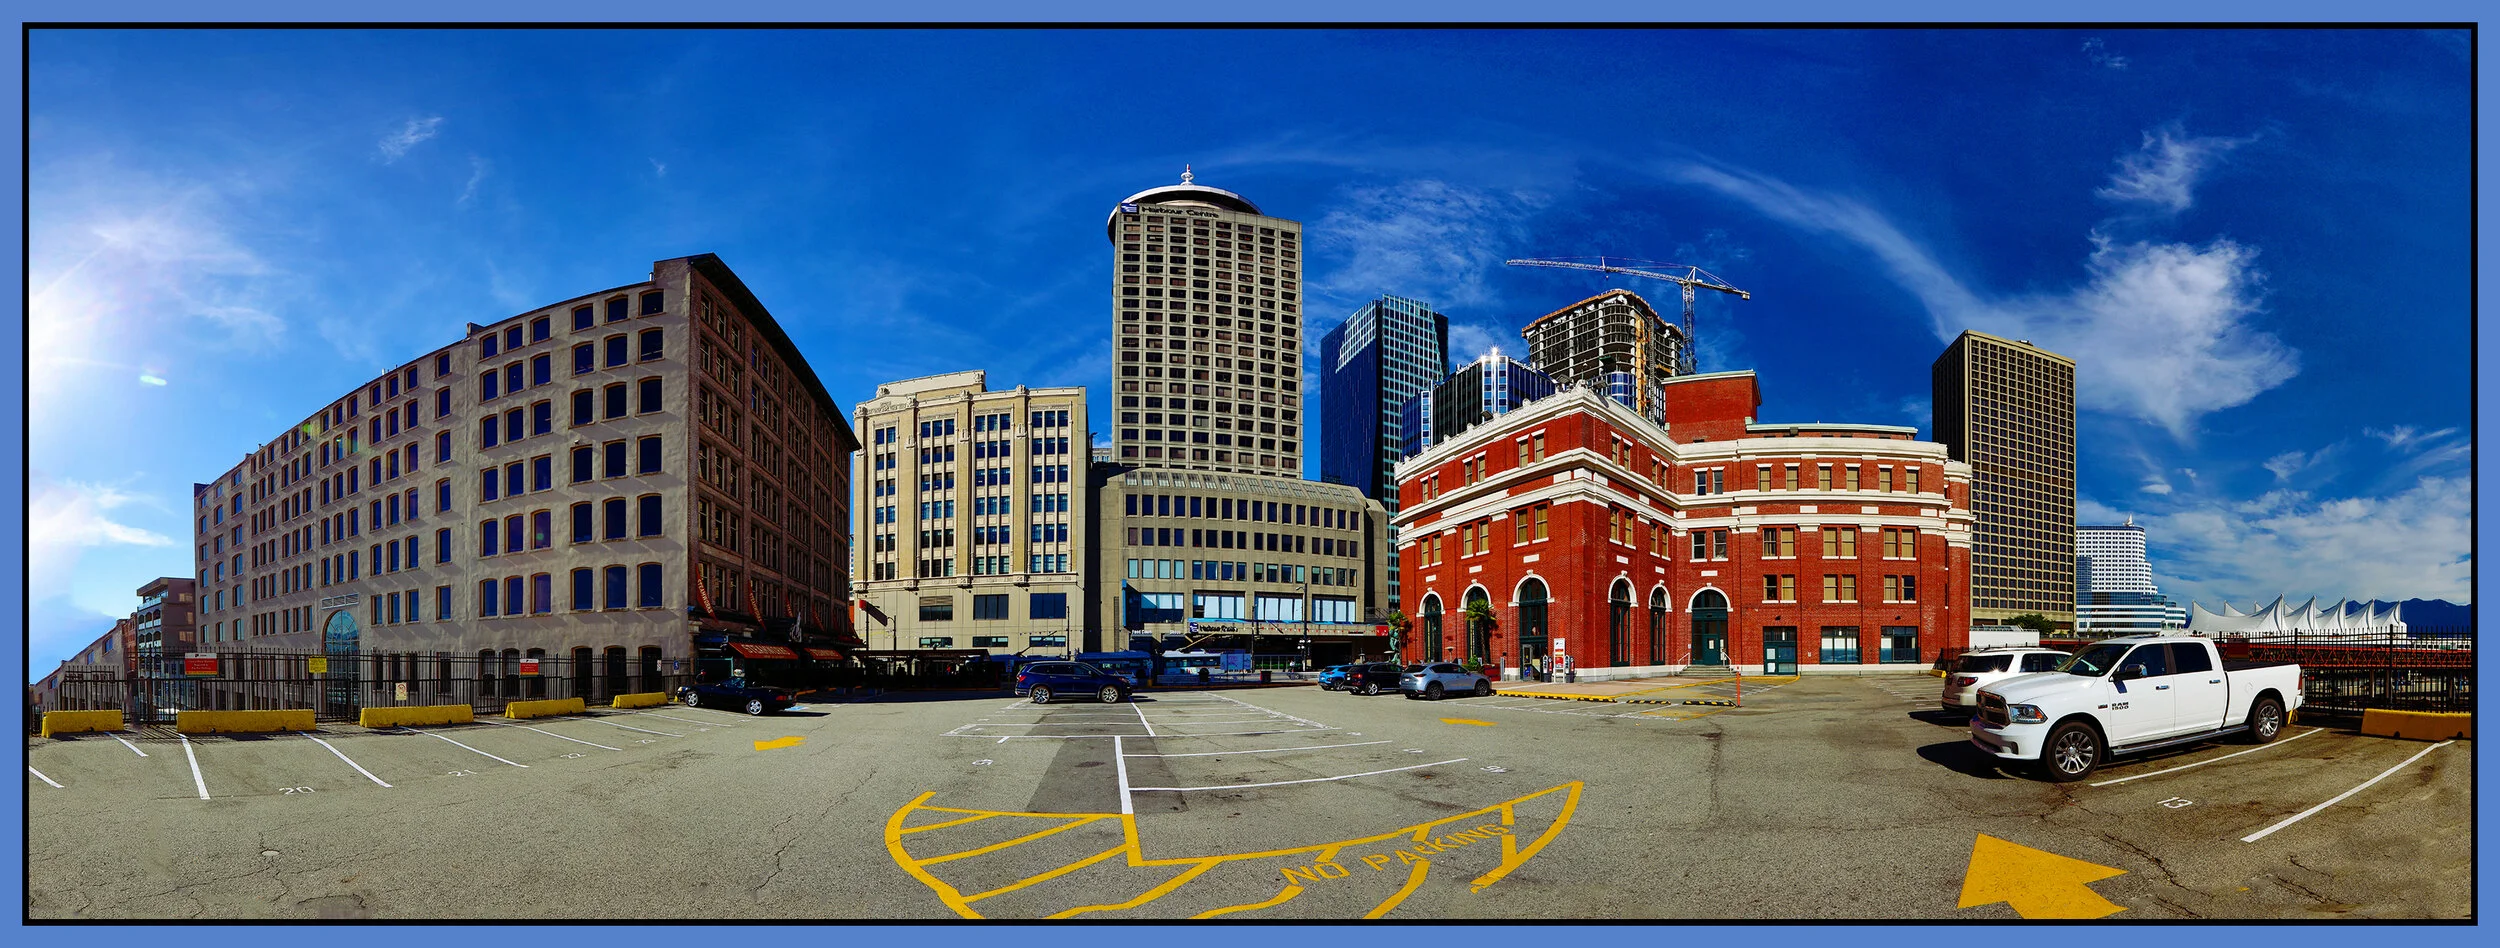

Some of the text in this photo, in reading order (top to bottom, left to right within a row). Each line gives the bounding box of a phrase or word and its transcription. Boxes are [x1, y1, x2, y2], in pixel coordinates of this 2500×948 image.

[1142, 206, 1219, 218] Harbour Centre
[697, 578, 713, 614] STEAMWORKS
[278, 786, 315, 795] 20
[2157, 796, 2193, 808] 13
[1279, 823, 1510, 886] NO PARKING
